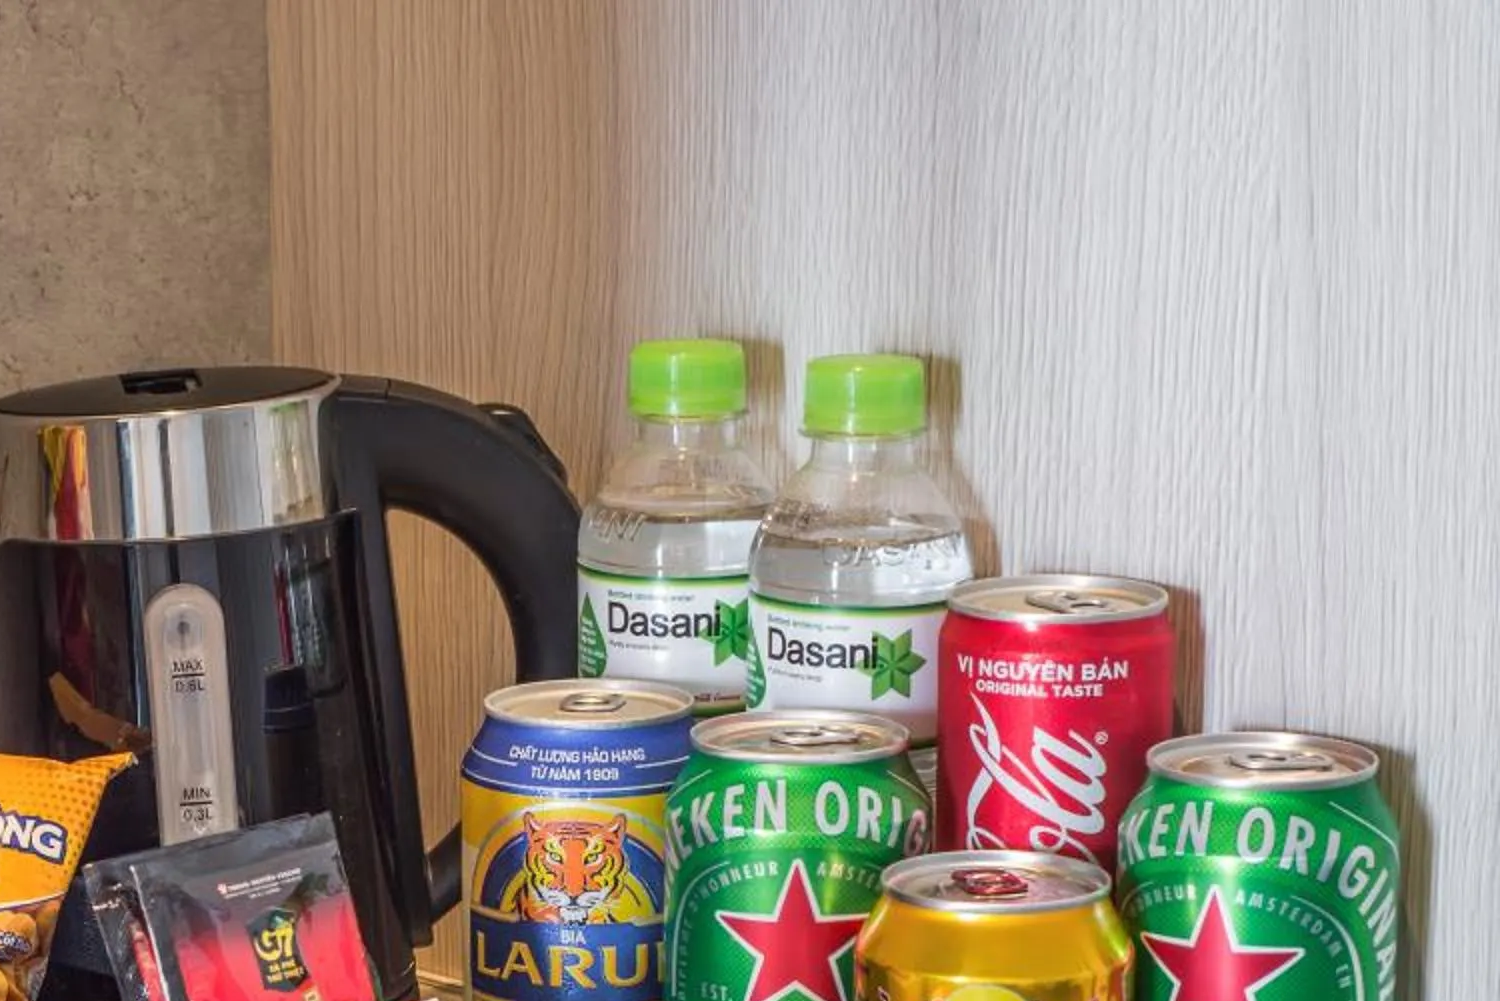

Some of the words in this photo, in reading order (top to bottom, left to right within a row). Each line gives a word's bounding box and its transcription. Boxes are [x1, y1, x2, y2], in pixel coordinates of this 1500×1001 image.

[607, 601, 721, 638] Dasani
[767, 626, 879, 669] Dasani
[173, 660, 204, 673] MAX
[975, 678, 1049, 698] ORIGINAL
[1053, 683, 1104, 698] TASTE
[183, 787, 211, 800] MIN
[814, 779, 930, 857] ORIG
[560, 930, 587, 945] BIA
